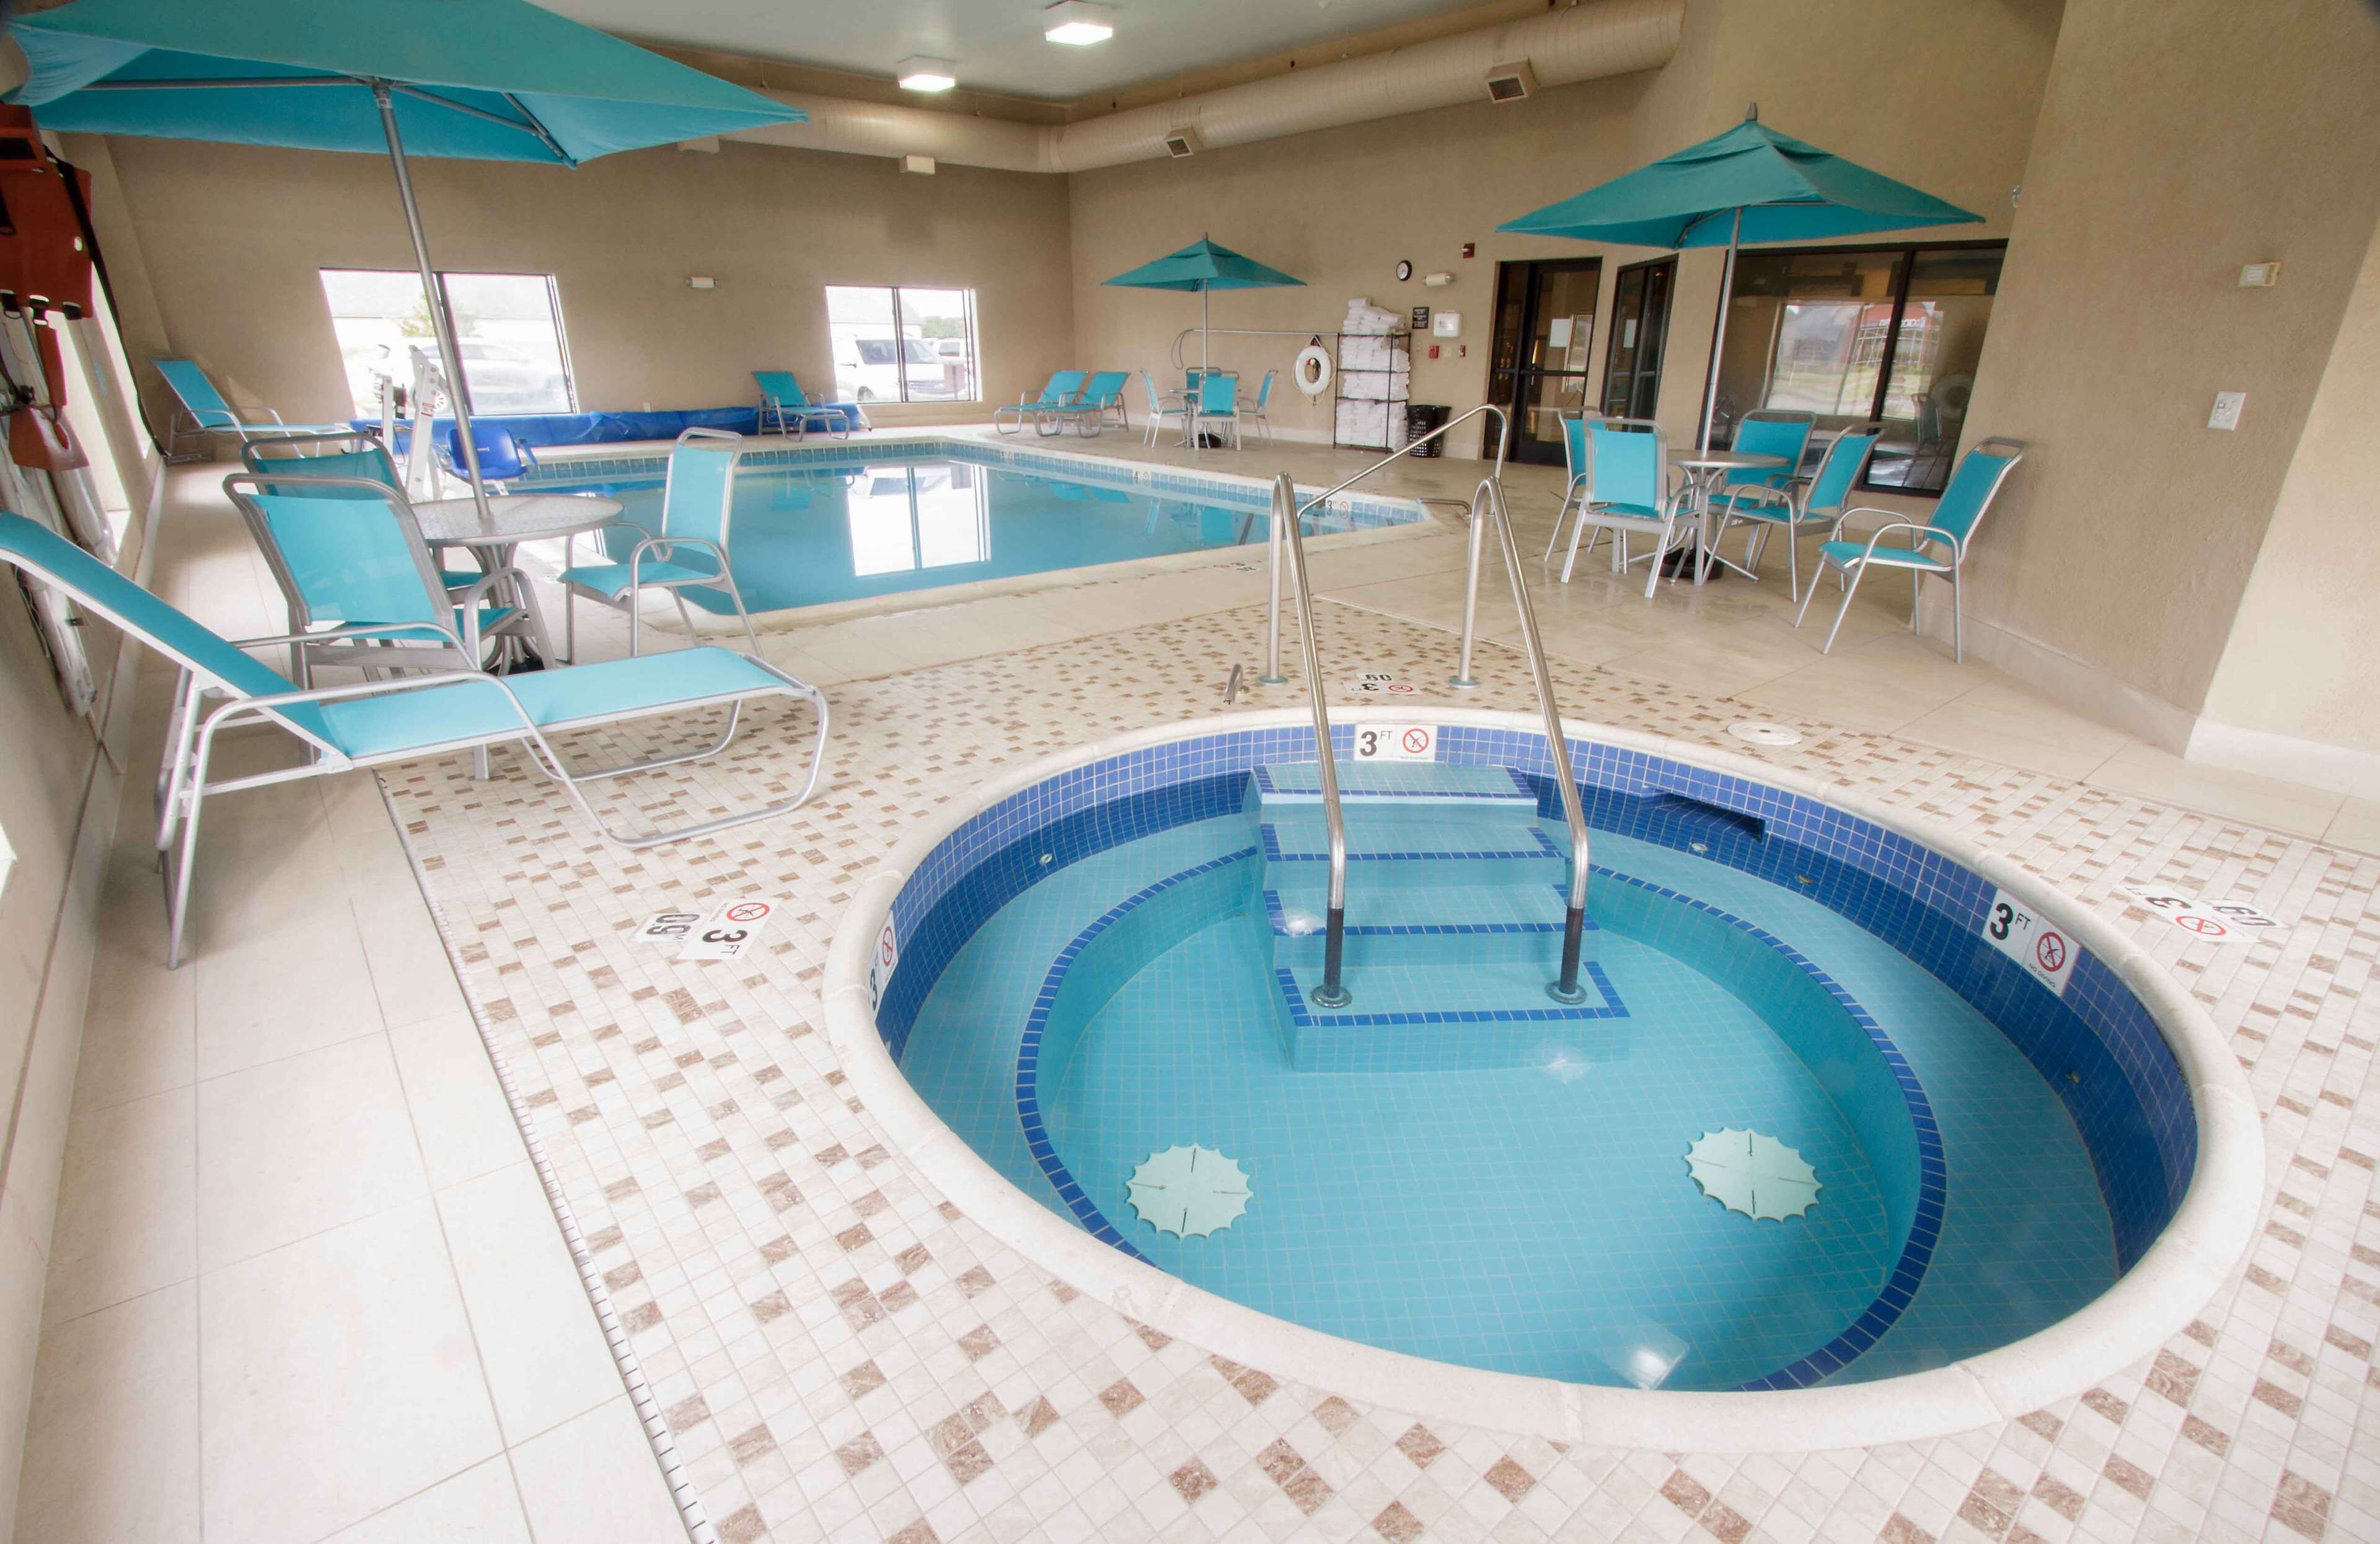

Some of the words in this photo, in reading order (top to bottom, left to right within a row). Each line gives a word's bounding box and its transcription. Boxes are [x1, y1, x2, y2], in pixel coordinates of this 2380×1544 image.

[1326, 500, 1333, 516] 3
[1360, 731, 1378, 757] 3
[1380, 730, 1393, 740] FT
[1990, 902, 2014, 940] 3
[2015, 912, 2032, 930] FT
[702, 929, 748, 943] 3
[720, 945, 740, 955] FT
[2028, 963, 2037, 973] NO
[2037, 971, 2057, 989] DIVING
